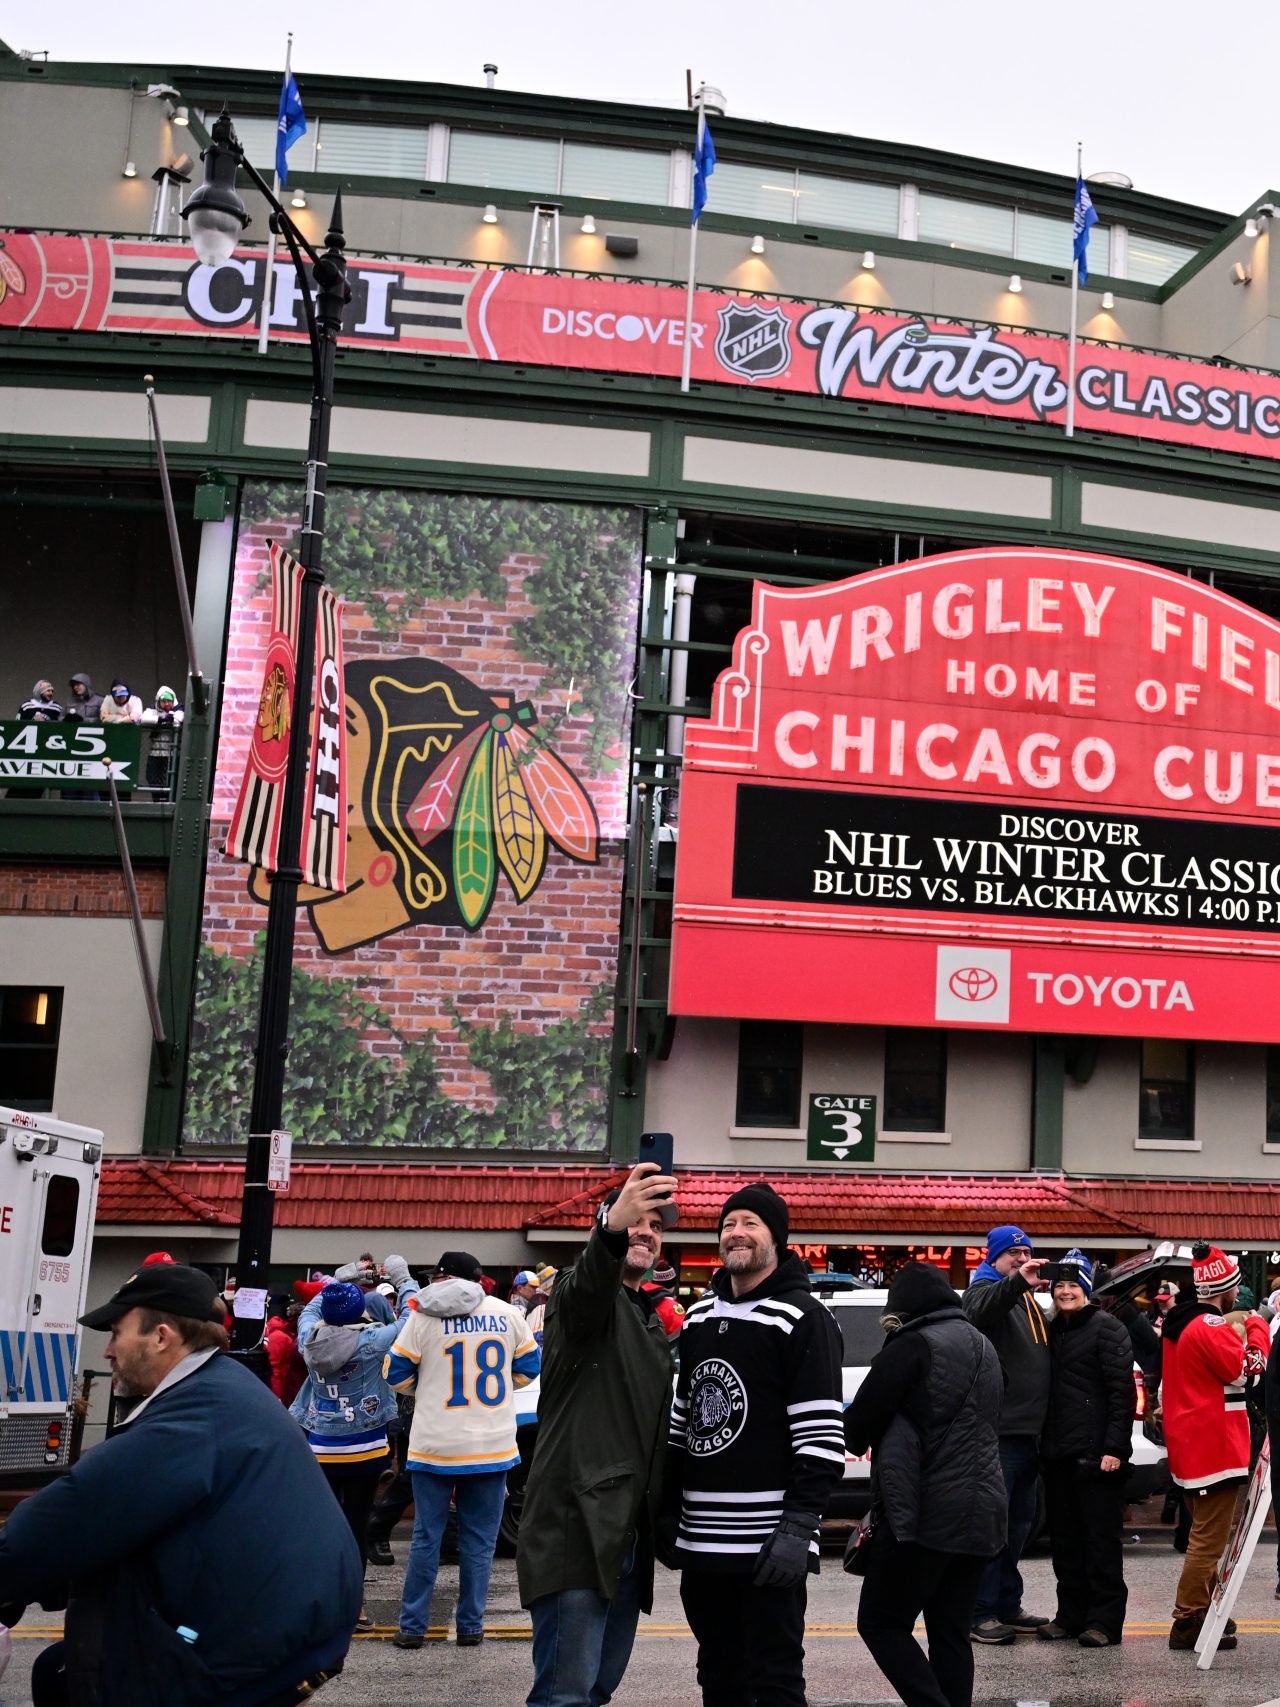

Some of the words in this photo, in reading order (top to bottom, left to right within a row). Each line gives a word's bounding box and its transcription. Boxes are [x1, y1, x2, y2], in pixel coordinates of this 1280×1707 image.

[542, 305, 706, 350] DISCOVER
[732, 324, 777, 361] NHL
[800, 308, 1067, 409] Winter
[780, 577, 1116, 678] WRIGLEY
[947, 659, 1097, 707] HOME
[1135, 679, 1201, 716] OF
[314, 659, 340, 824] CHI
[774, 710, 1117, 793] CHICAGO
[0, 761, 92, 777] AVENUE
[999, 814, 1141, 846] DISCOVER
[825, 829, 922, 869] NHL
[933, 837, 1108, 883] WINTER
[813, 869, 911, 900] BLUES
[921, 876, 966, 903] VS.
[974, 881, 1181, 918] BLACKHAWKS
[1198, 898, 1250, 922] 4:00
[1027, 972, 1195, 1013] TOYOTA
[813, 1096, 872, 1110] GATE
[820, 1110, 863, 1147] 3
[39, 1260, 71, 1283] 6755
[440, 1315, 509, 1335] THOMAS
[443, 1336, 508, 1409] 18
